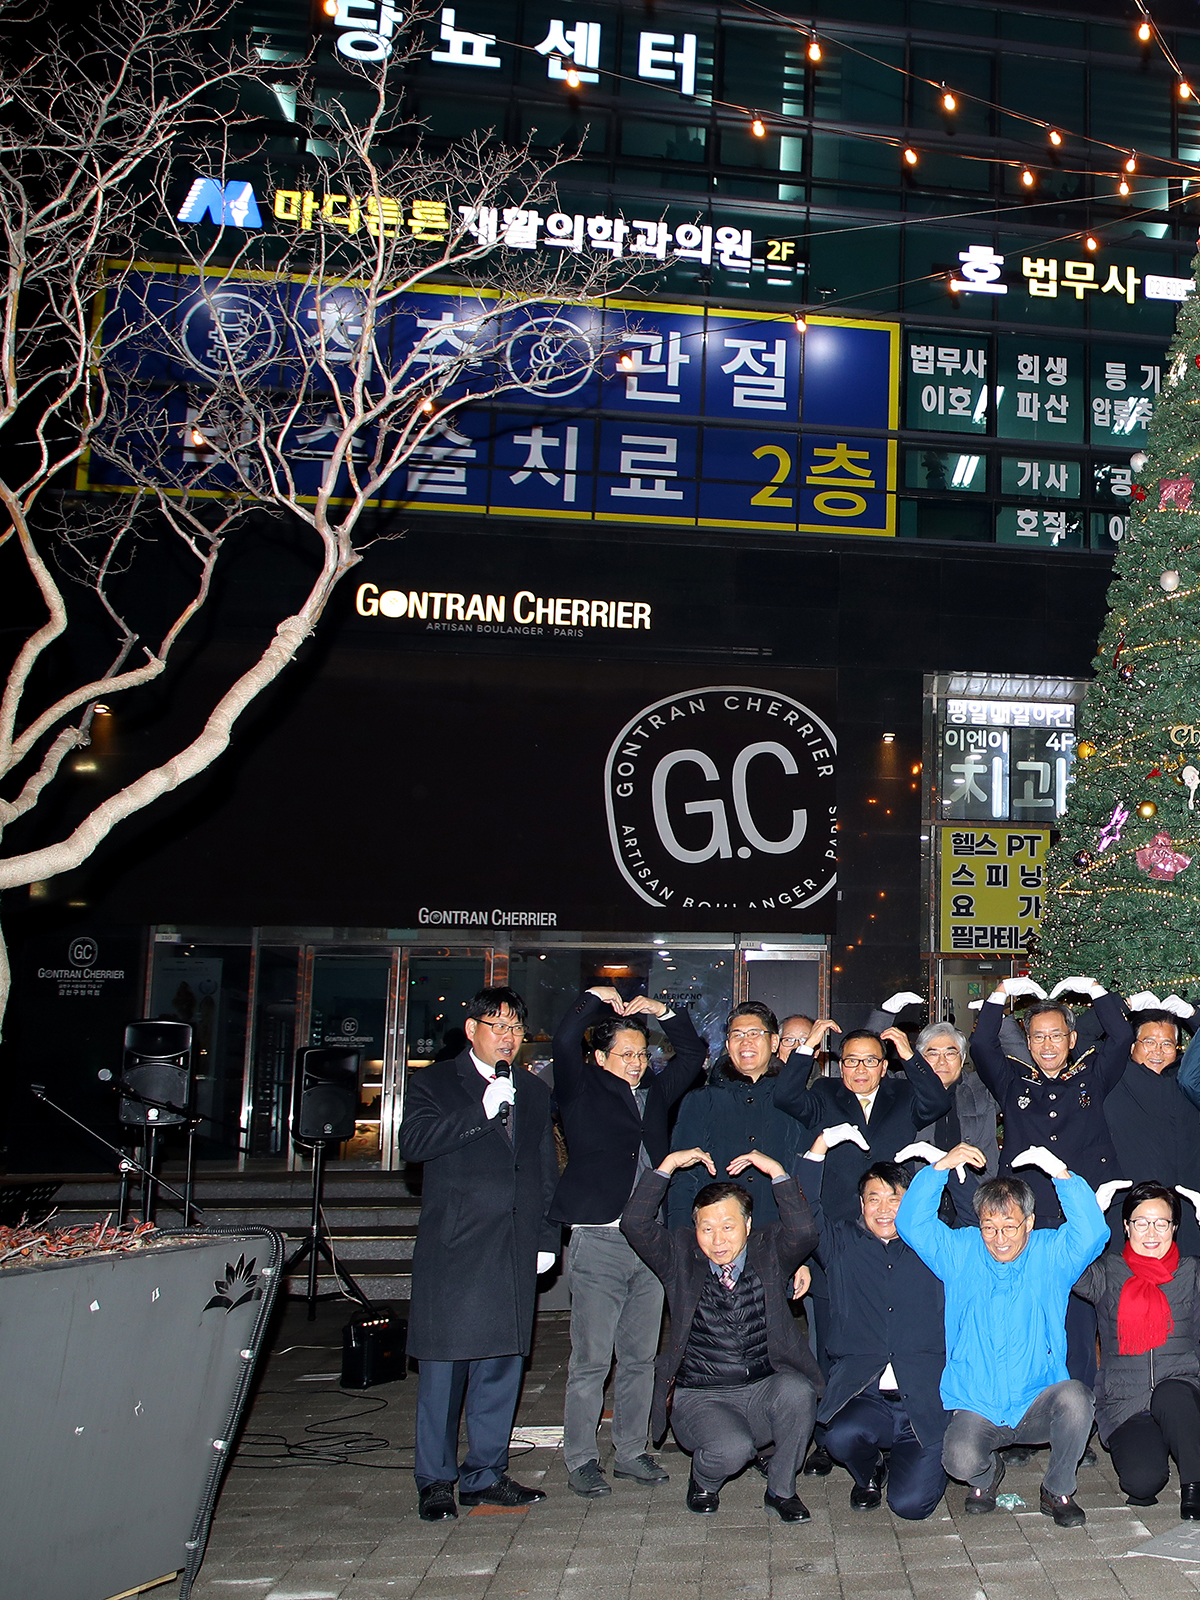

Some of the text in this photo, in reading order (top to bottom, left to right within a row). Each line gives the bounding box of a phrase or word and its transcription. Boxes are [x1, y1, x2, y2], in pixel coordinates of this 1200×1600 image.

[457, 205, 752, 268] 재활의학과의원
[766, 240, 796, 262] 2F
[1022, 256, 1141, 304] 법무사
[616, 331, 787, 411] 관절
[910, 344, 987, 379] 법무사
[1017, 354, 1068, 386] 회생
[1104, 362, 1161, 394] 등기
[921, 385, 972, 416] 이호
[1016, 391, 1069, 424] 파산
[750, 443, 876, 518] 2층
[1017, 461, 1068, 492] 가사
[1016, 509, 1066, 539] 호적
[356, 582, 651, 630] GONTRAN CHERRIER
[426, 621, 584, 638] ARTISAN BOULANGER PARIS
[616, 696, 834, 798] GONTRAN CHERRIER
[945, 728, 1075, 754] 이엔이 4F
[950, 832, 1043, 858] 헬스 PT
[622, 825, 675, 901] ARTISAN
[950, 863, 1043, 889] 스피닝
[418, 907, 557, 927] GONTRAN CHERRIER
[37, 967, 125, 979] GONTRAN CHERRIER
